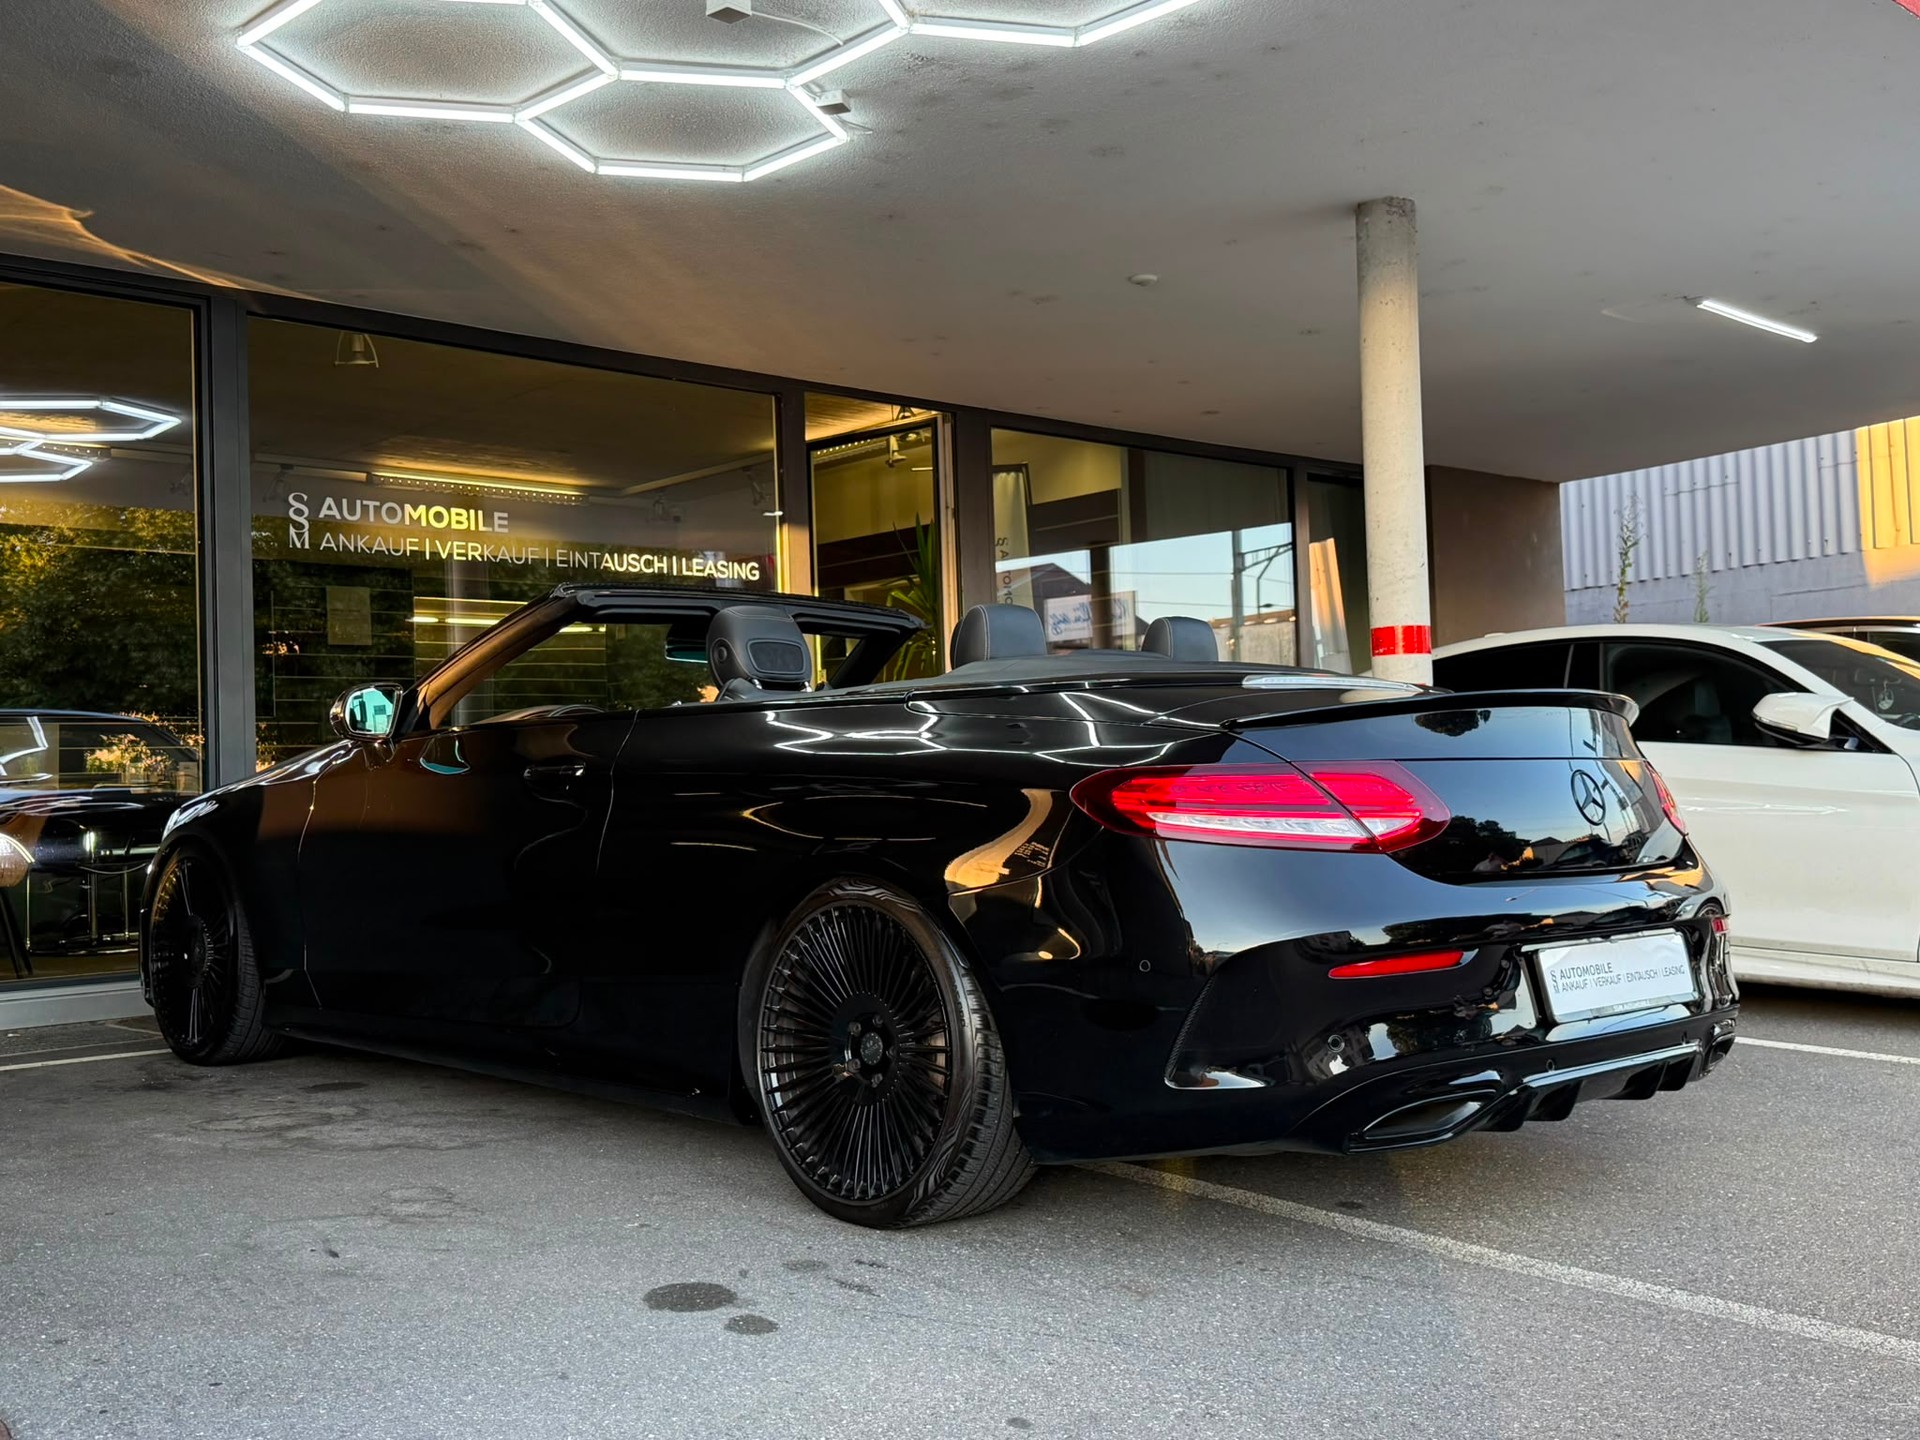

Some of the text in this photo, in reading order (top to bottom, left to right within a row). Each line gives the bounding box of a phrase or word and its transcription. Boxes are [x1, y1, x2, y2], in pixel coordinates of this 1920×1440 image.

[318, 497, 509, 533] AUTOMOBILE
[319, 532, 419, 557] ANKAUF
[435, 539, 541, 565] VERKAUF
[556, 549, 668, 574] EINTAUSCH
[682, 556, 760, 581] LEASING
[1560, 962, 1613, 980] AUTOMOBILE
[1562, 978, 1588, 992] ANKAUF
[1593, 974, 1622, 988] VERKAUF
[1661, 964, 1685, 977] LEASING
